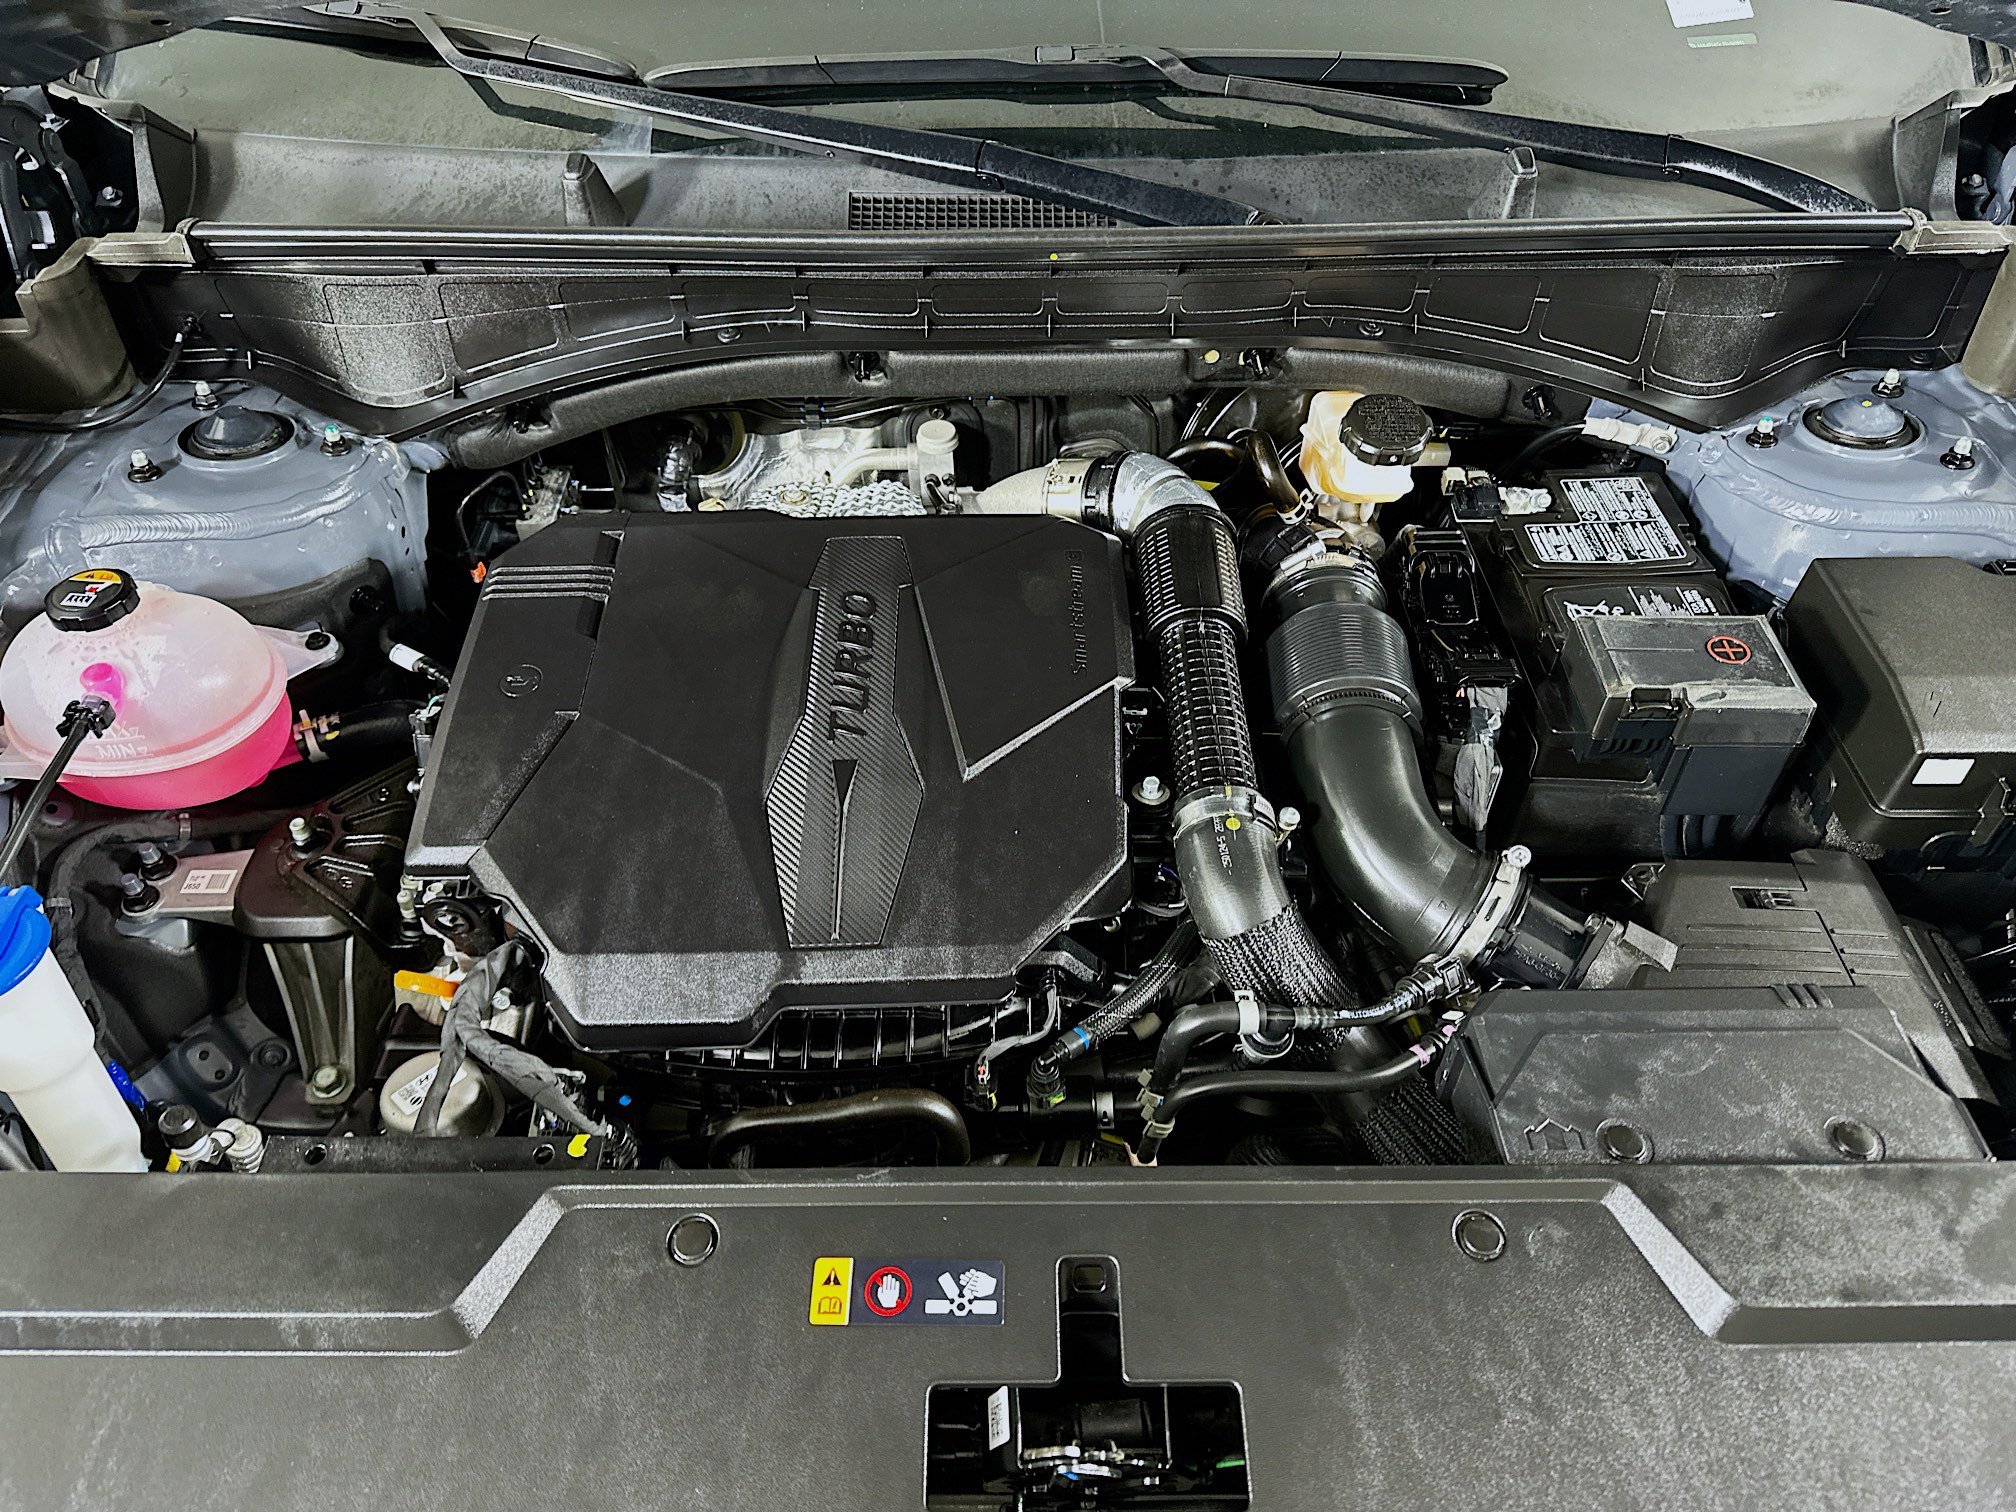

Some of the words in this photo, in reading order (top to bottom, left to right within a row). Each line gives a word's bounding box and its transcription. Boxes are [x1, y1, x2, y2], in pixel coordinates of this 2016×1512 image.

[827, 590, 877, 744] TURBO
[1068, 564, 1087, 675] Smartstream
[95, 743, 137, 760] MIN
